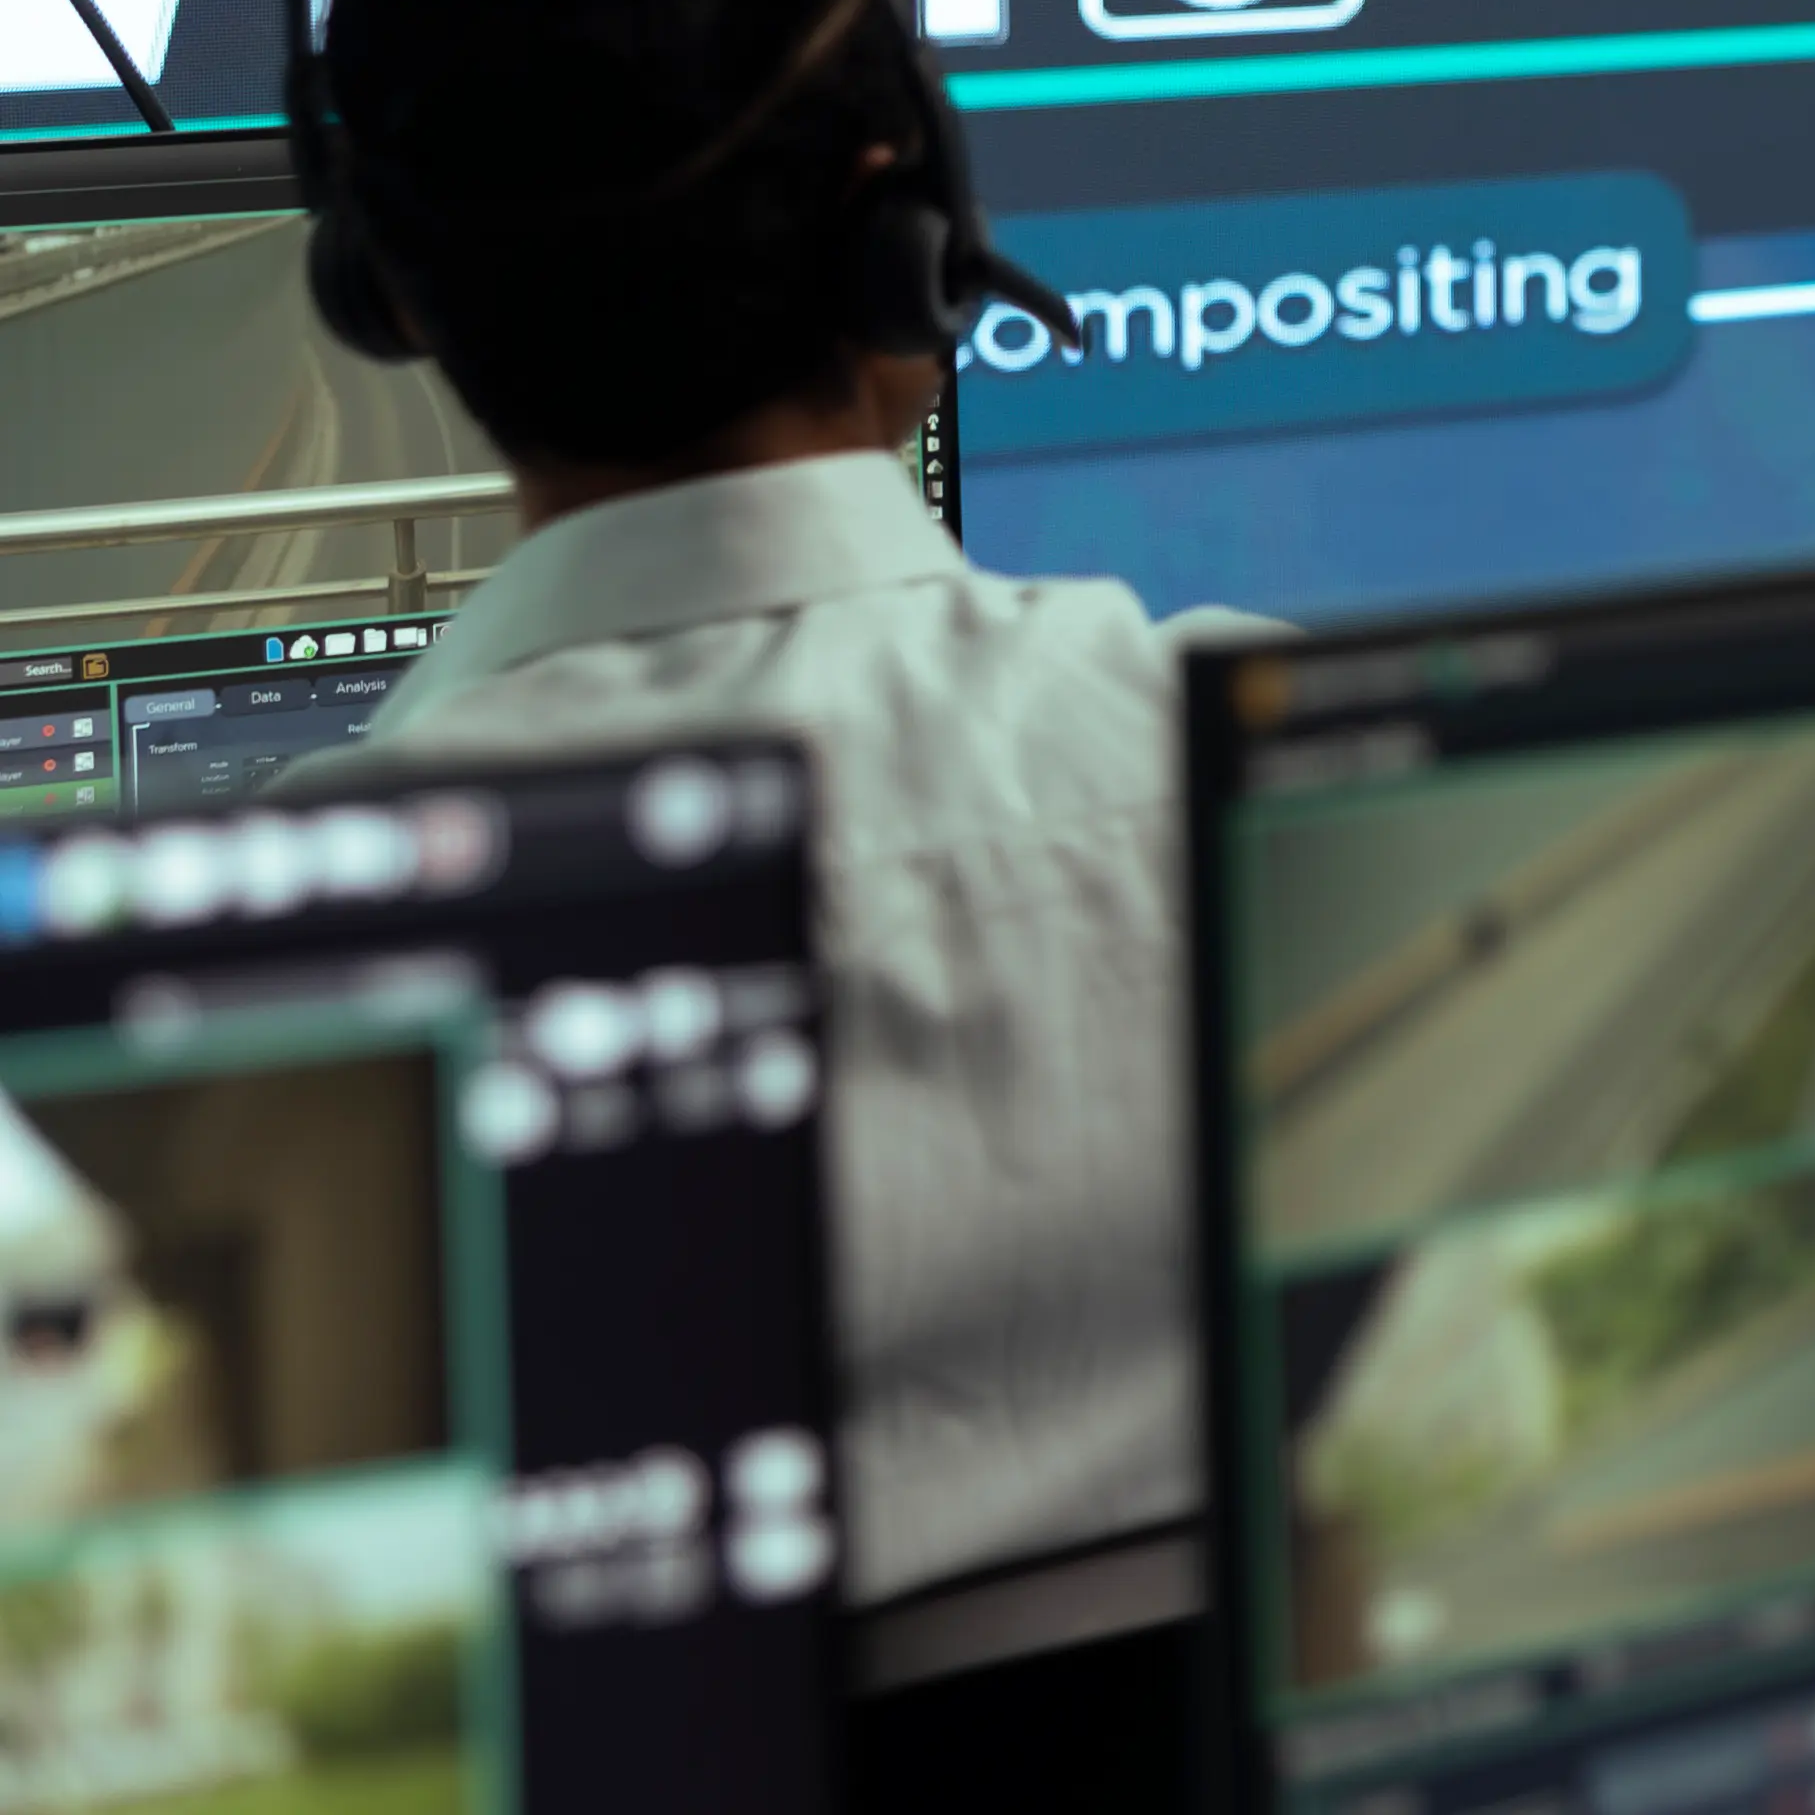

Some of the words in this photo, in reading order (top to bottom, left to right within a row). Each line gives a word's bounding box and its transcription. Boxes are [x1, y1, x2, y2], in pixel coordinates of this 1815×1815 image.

[956, 237, 1643, 372] ompositing
[335, 678, 387, 695] Analysis
[250, 691, 282, 705] Data
[146, 698, 196, 715] General
[0, 737, 22, 747] ayer
[149, 740, 197, 755] Transform
[0, 771, 23, 782] ayer
